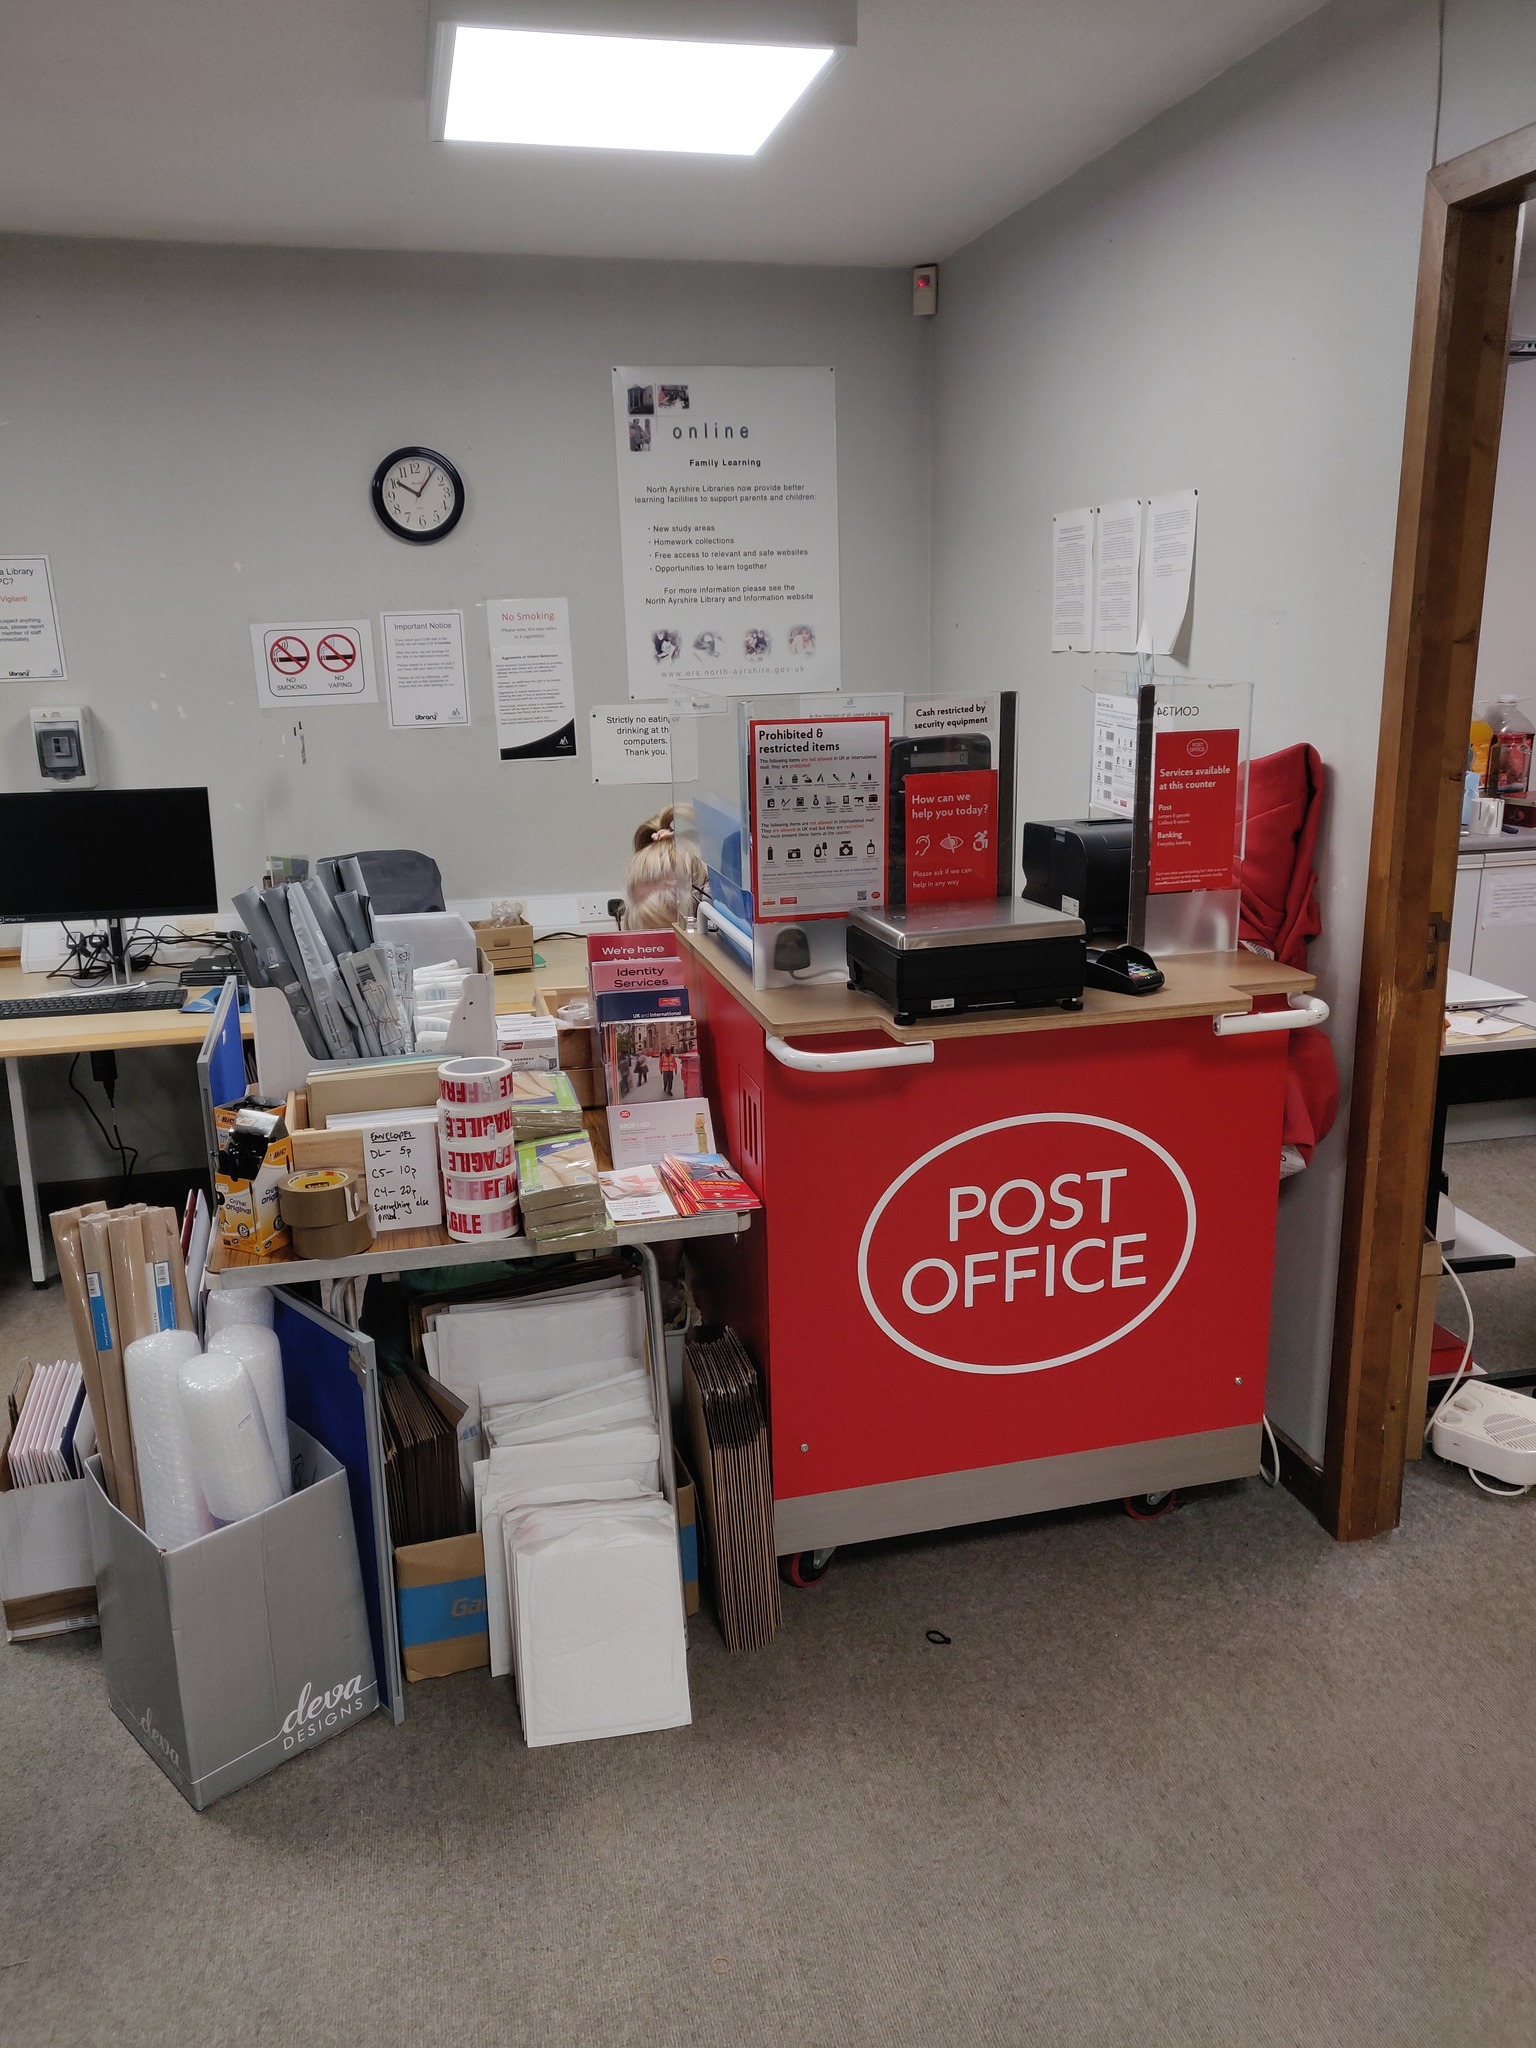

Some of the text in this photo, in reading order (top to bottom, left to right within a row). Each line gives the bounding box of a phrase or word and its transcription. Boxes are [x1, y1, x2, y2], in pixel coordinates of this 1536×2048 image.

[673, 422, 749, 439] online
[409, 462, 421, 474] 12
[689, 459, 761, 468] Family Learning
[399, 466, 407, 478] 11
[437, 475, 444, 486] 2
[443, 487, 451, 498] 3
[646, 485, 667, 493] North
[669, 485, 700, 494] Ayrshire
[754, 484, 781, 492] provide
[387, 491, 396, 502] 9
[634, 496, 665, 504] learning
[667, 495, 698, 503] facilities
[709, 495, 738, 503] support
[393, 503, 401, 515] 8
[405, 511, 411, 523] 7
[419, 515, 427, 527] 6
[433, 510, 440, 522] 5
[672, 525, 692, 533] study
[695, 537, 734, 545] collections
[654, 551, 671, 559] Free
[743, 549, 756, 557] and
[7, 568, 33, 576] Library
[655, 564, 705, 573] Opportunities
[737, 563, 767, 571] together
[742, 585, 766, 593] please
[645, 597, 666, 605] North
[668, 596, 698, 605] Ayrshire
[700, 595, 725, 604] Library
[501, 612, 555, 621] No Smoking
[394, 622, 428, 631] Important
[328, 681, 353, 689] VAPING
[915, 703, 986, 717] Cash restricted by
[606, 716, 634, 725] Strictly
[914, 717, 988, 730] security equipment
[616, 726, 650, 735] drinking
[661, 726, 669, 734] th
[759, 728, 824, 740] Prohibited &
[623, 737, 669, 747] computers.
[759, 741, 840, 754] restricted items
[625, 748, 668, 757] Thank you.
[1159, 765, 1231, 777] Services available
[1169, 781, 1184, 790] this
[1185, 779, 1217, 788] counter
[911, 793, 971, 805] How can we
[912, 804, 989, 820] help you today?
[1158, 803, 1172, 811] Post
[1157, 831, 1183, 839] Banking
[601, 945, 665, 955] We're here
[617, 967, 664, 977] Identity
[614, 978, 669, 988] Services
[273, 1148, 286, 1159] BIC
[416, 1196, 430, 1206] else
[949, 1168, 1128, 1242] POST
[902, 1232, 1148, 1315] OFFICE
[452, 1597, 487, 1617] Ga
[281, 1674, 364, 1735] deva
[282, 1697, 364, 1751] DESIGNS
[140, 1707, 180, 1767] deva
